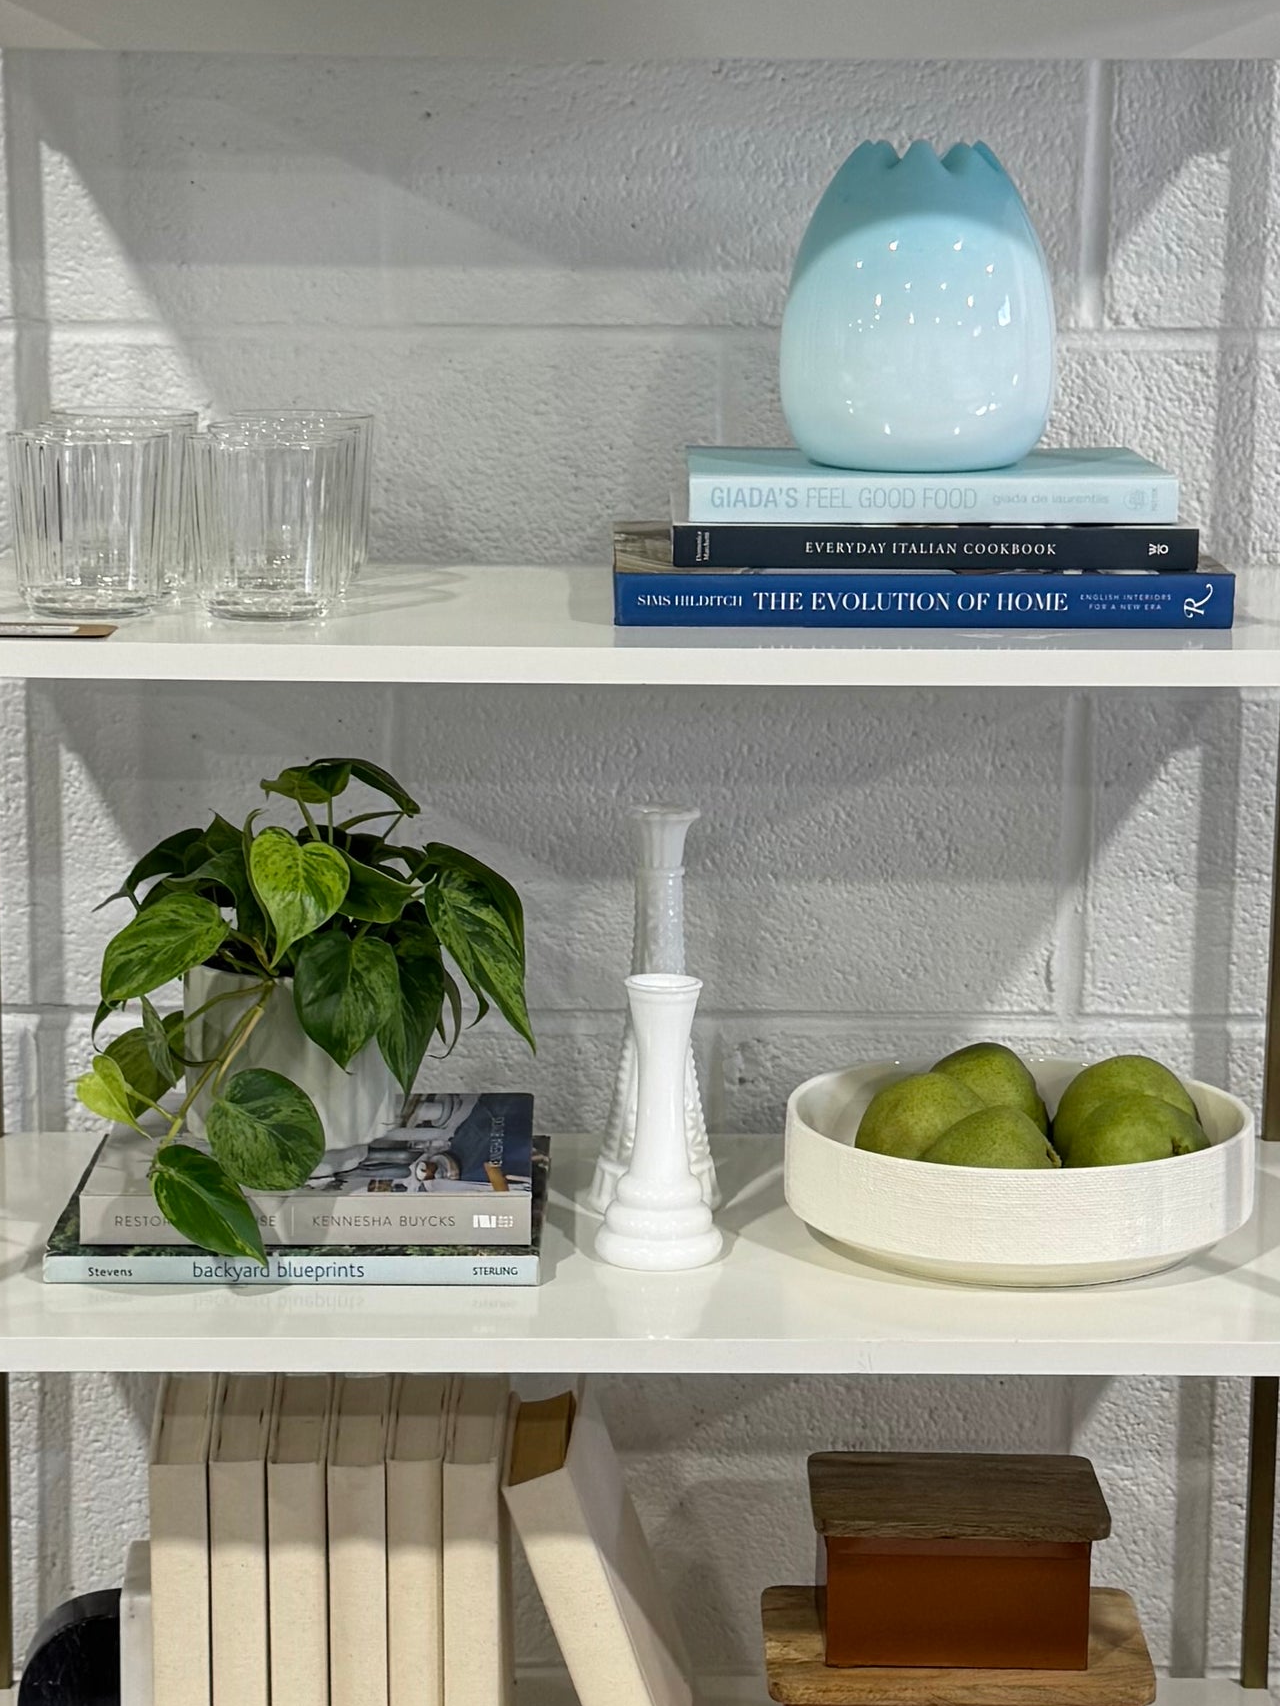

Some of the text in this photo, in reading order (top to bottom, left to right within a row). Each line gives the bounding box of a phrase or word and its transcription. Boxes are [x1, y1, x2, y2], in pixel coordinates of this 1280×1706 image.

[711, 487, 977, 510] GIADA'S FEEL GOOD FOOD
[805, 541, 1057, 555] EVERYDAY ITALIAN COOKBOOK
[637, 595, 742, 607] SIMS HILDITCH
[753, 592, 1068, 611] THE EVOLUTION OF HOME
[312, 1215, 455, 1227] KENNESHA BUYCKS
[88, 1266, 133, 1277] Stevens
[193, 1262, 364, 1281] backyard blueprints
[472, 1266, 518, 1276] STERLING
